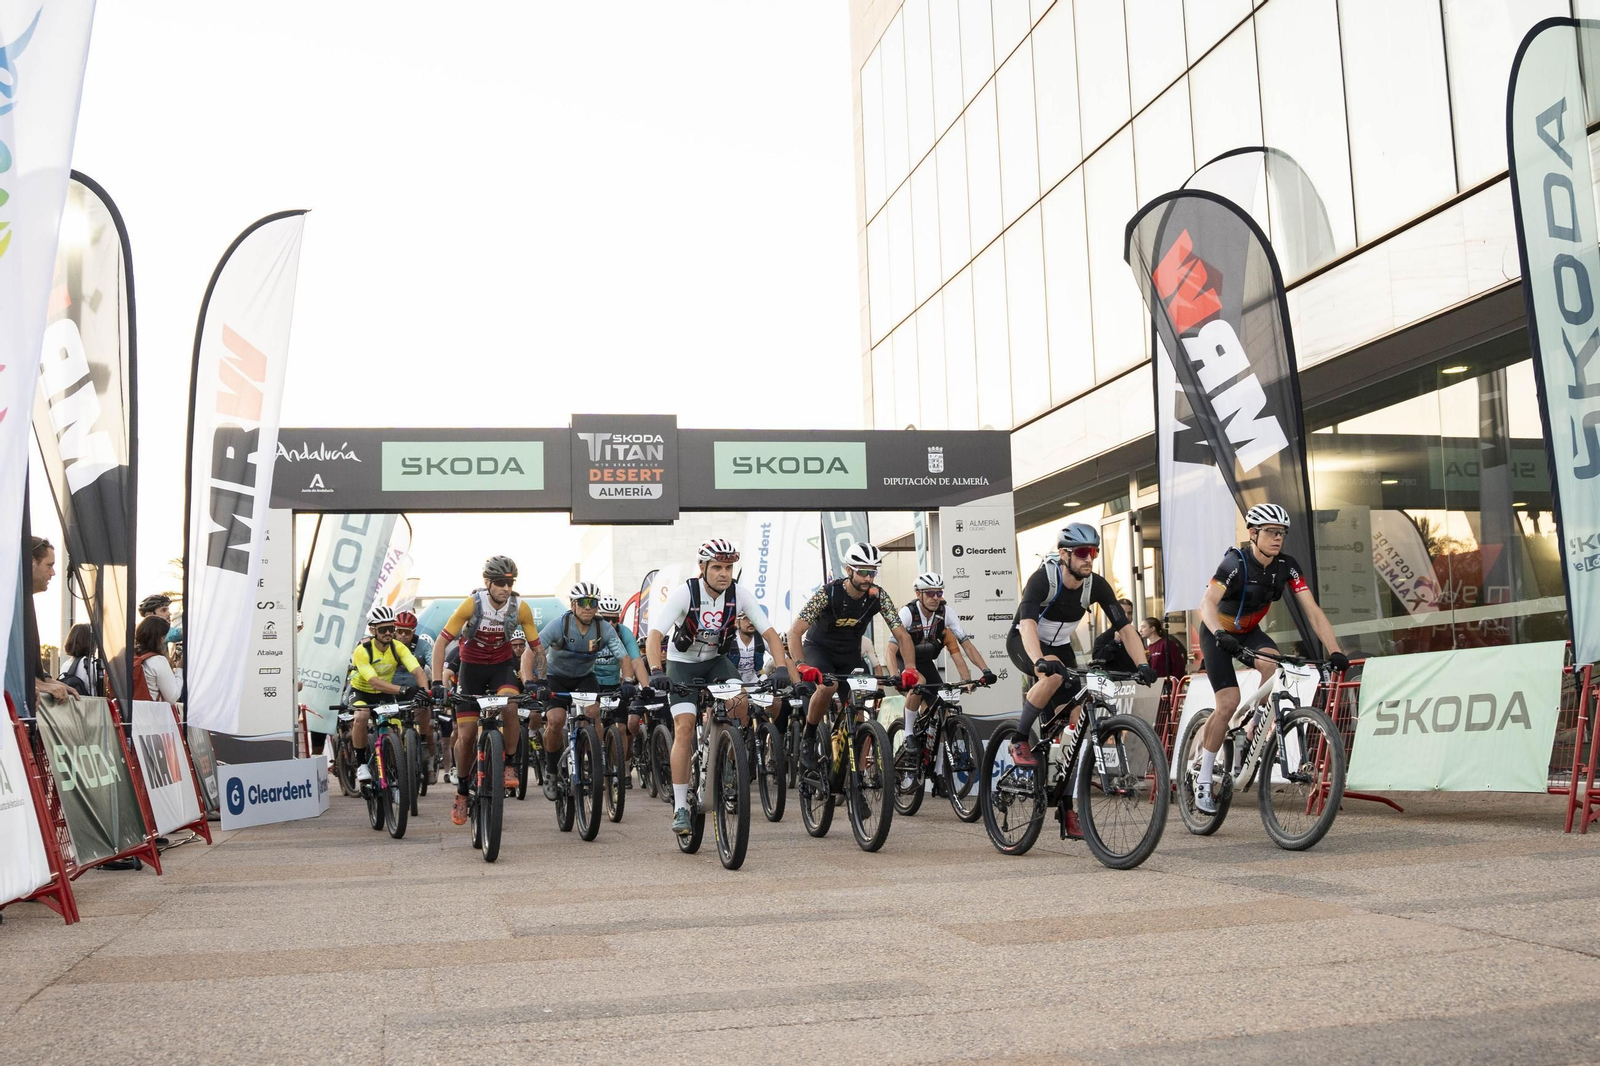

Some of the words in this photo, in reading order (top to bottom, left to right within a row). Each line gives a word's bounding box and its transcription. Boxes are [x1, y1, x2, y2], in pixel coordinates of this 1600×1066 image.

[1152, 228, 1289, 473] MRW
[577, 433, 664, 462] TITAN
[612, 434, 664, 443] SKODA
[207, 323, 267, 575] MRW
[275, 441, 362, 463] Andalucía
[401, 457, 525, 475] SKODA
[733, 456, 849, 474] SKODA
[589, 469, 664, 481] DESERT
[883, 476, 937, 485] DIPUTACIÓN
[938, 477, 950, 485] DE
[952, 475, 989, 485] ALMERÍA
[599, 485, 652, 496] ALMERÍA
[966, 546, 1006, 554] Cleardent
[755, 522, 771, 599] Cleardent
[314, 514, 371, 649] SKOD
[318, 683, 341, 693] Cycling
[857, 678, 868, 686] 96
[1115, 684, 1136, 695] KODA
[1373, 691, 1532, 736] SKODA
[248, 779, 312, 805] Cleardent
